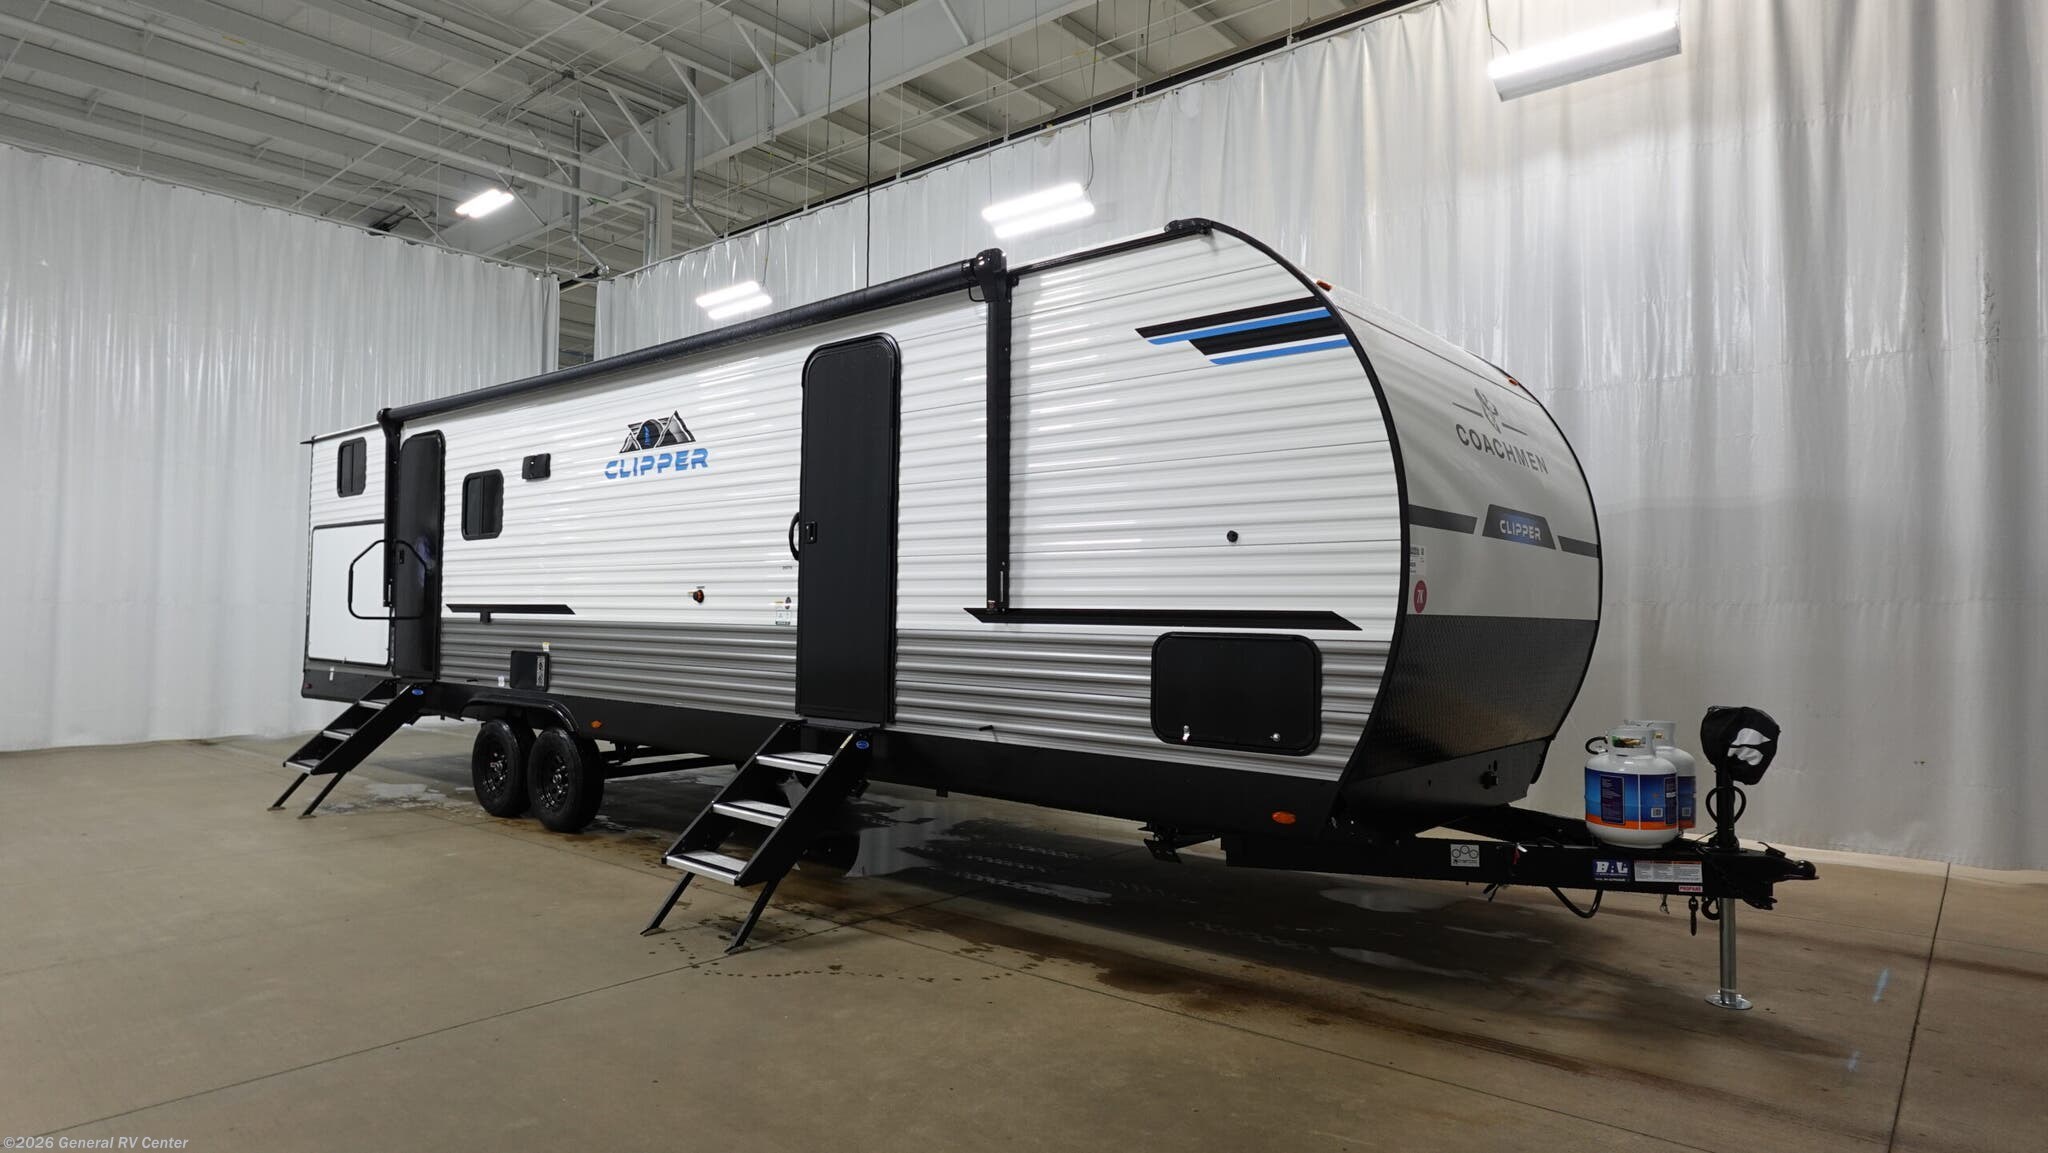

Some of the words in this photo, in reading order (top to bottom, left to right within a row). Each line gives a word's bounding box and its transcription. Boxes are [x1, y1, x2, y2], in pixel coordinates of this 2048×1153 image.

[604, 447, 709, 479] CLIPPER
[1455, 423, 1549, 474] COACHMEN
[1499, 519, 1542, 541] CLIPPER
